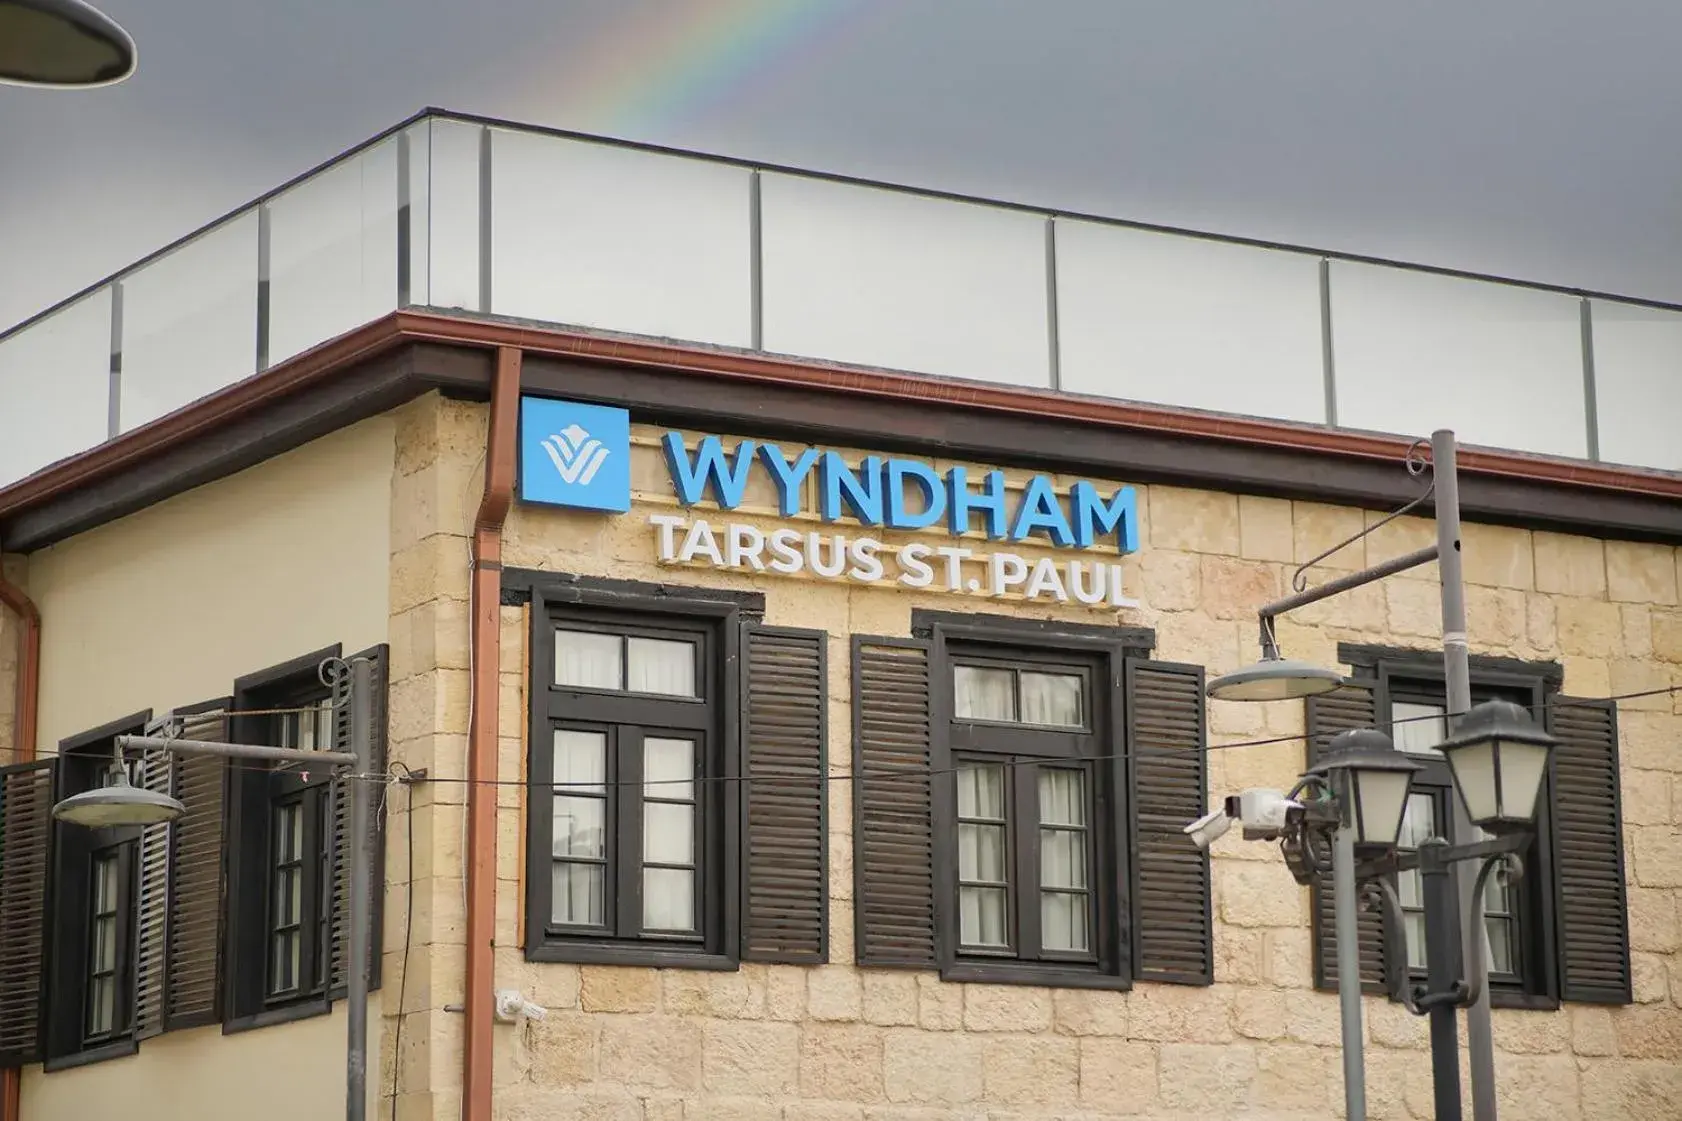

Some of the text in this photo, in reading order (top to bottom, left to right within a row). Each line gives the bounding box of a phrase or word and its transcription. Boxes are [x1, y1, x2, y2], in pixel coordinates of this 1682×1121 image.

[661, 430, 1138, 555] WYNDHAM
[647, 514, 1138, 609] TARSUS ST. PAUL
